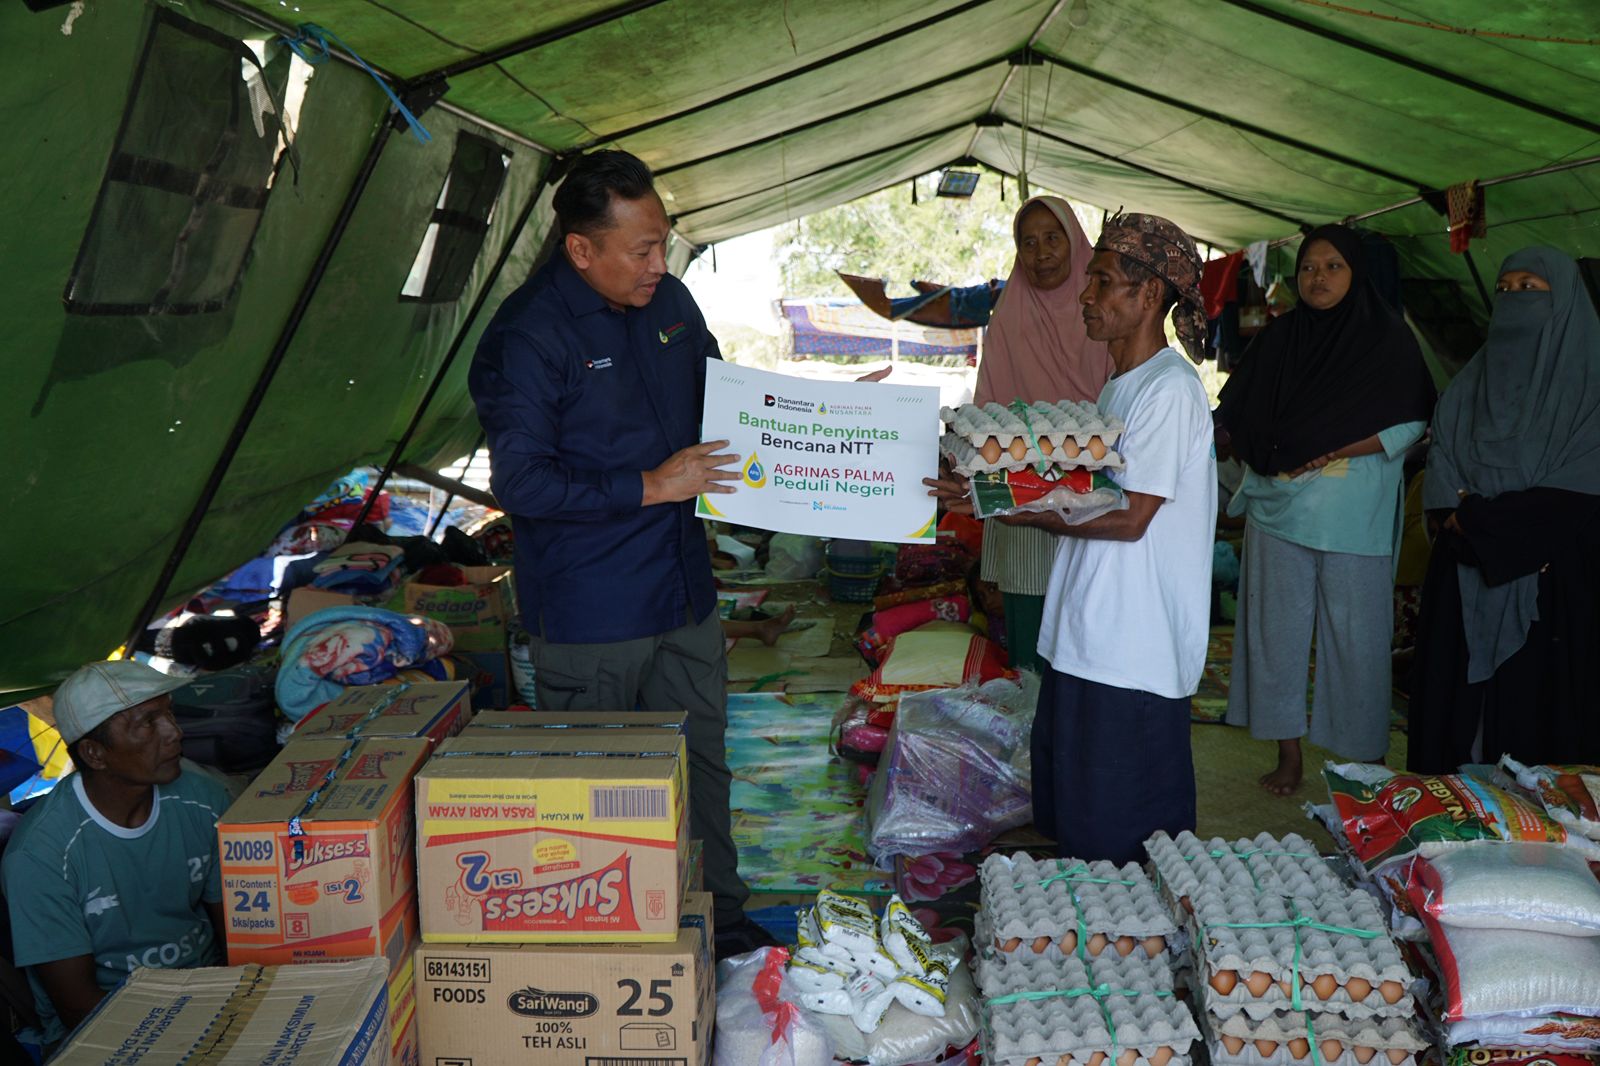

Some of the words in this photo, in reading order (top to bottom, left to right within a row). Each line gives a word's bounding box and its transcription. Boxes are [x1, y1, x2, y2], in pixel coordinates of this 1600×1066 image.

[777, 396, 815, 407] Danantara
[777, 403, 812, 413] Indonesia
[739, 411, 808, 435] Bantuan
[812, 423, 899, 441] Penyintas
[761, 432, 836, 453] Bencana
[840, 441, 874, 455] NTT
[774, 463, 840, 479] AGRINAS
[844, 468, 894, 482] PALMA
[774, 475, 829, 492] Peduli
[835, 480, 895, 497] Negeri
[428, 805, 465, 818] AYAM
[469, 806, 498, 818] KARI
[502, 806, 535, 818] RASA
[541, 812, 569, 821] KUAH
[572, 812, 584, 820] MI
[223, 840, 274, 861] 20089
[461, 855, 489, 892] 2
[494, 871, 519, 885] ISI
[224, 879, 235, 888] Isi
[239, 879, 271, 889] Content
[326, 883, 342, 892] ISI
[343, 879, 362, 900] 2
[233, 890, 271, 912] 24
[485, 868, 623, 922] Sukses's
[232, 917, 275, 930] bks/packs
[292, 920, 303, 933] 8
[584, 916, 608, 924] Instan
[610, 916, 620, 924] Mi
[427, 961, 487, 978] 68143151
[433, 987, 486, 1003] FOODS
[616, 978, 674, 1016] 25
[518, 996, 589, 1013] SariWangi
[131, 1007, 165, 1037] BASAH
[141, 995, 192, 1045] HINDARKAN
[274, 995, 316, 1047] MAKSIMUM
[535, 1022, 573, 1034] 100%
[113, 1038, 138, 1057] DAN
[283, 1022, 316, 1061] KARTON
[522, 1035, 551, 1049] TEH
[556, 1036, 587, 1049] ASLI
